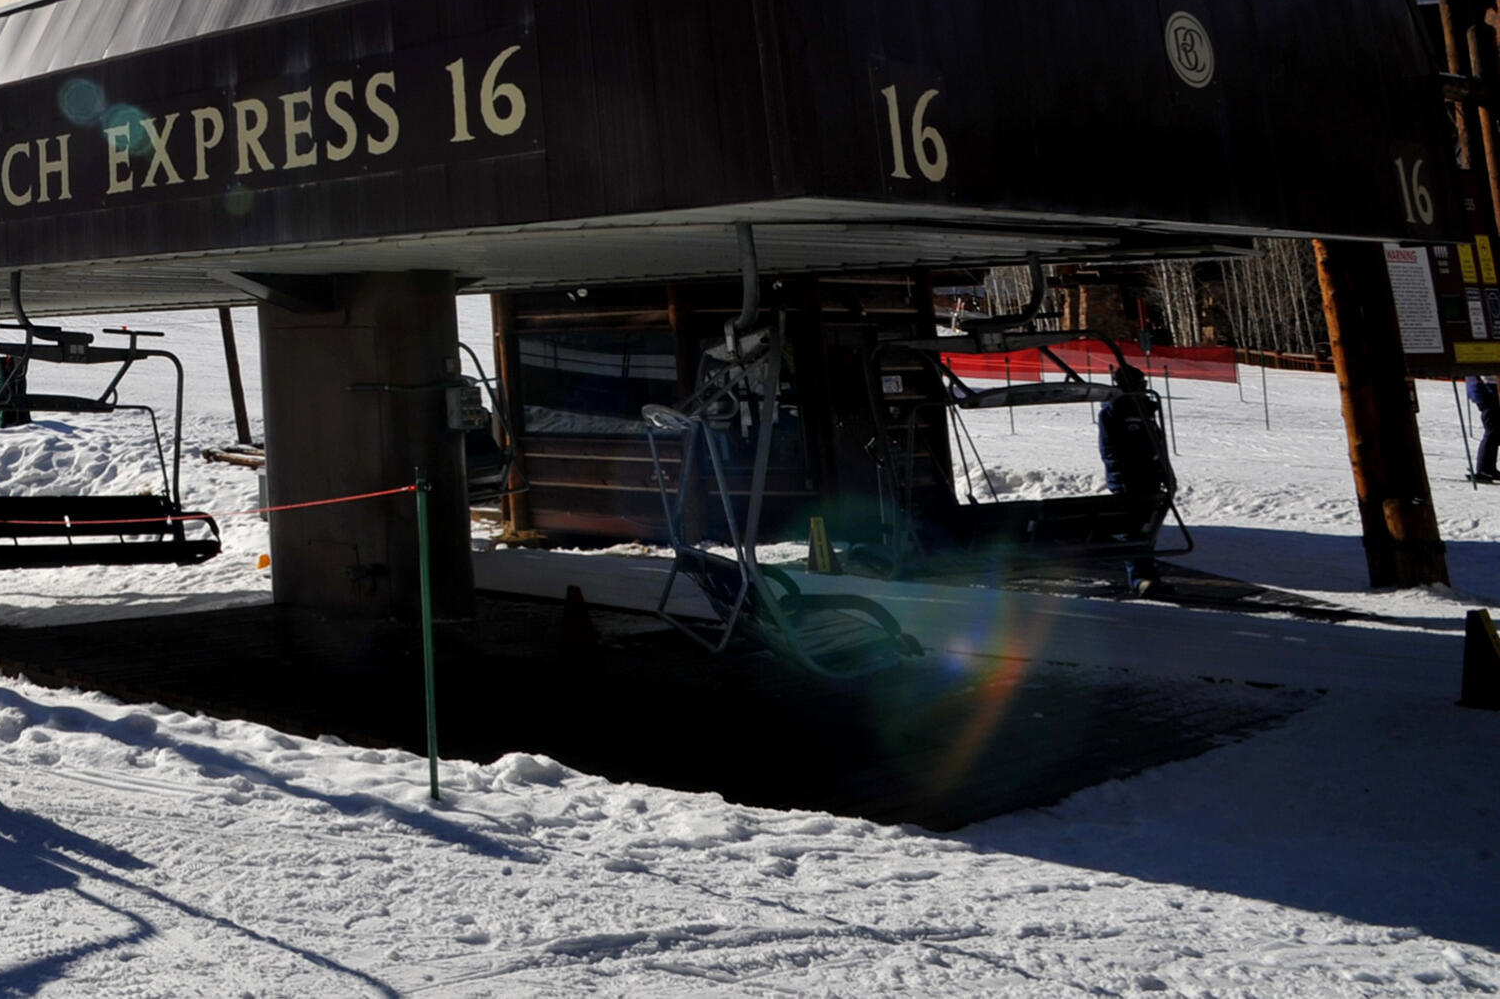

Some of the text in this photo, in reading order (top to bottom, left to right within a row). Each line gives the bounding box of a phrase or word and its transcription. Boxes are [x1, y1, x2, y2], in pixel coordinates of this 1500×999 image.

[103, 70, 400, 196] EXPRESS
[445, 45, 527, 143] 16
[881, 84, 948, 182] 16
[1395, 157, 1434, 225] 16
